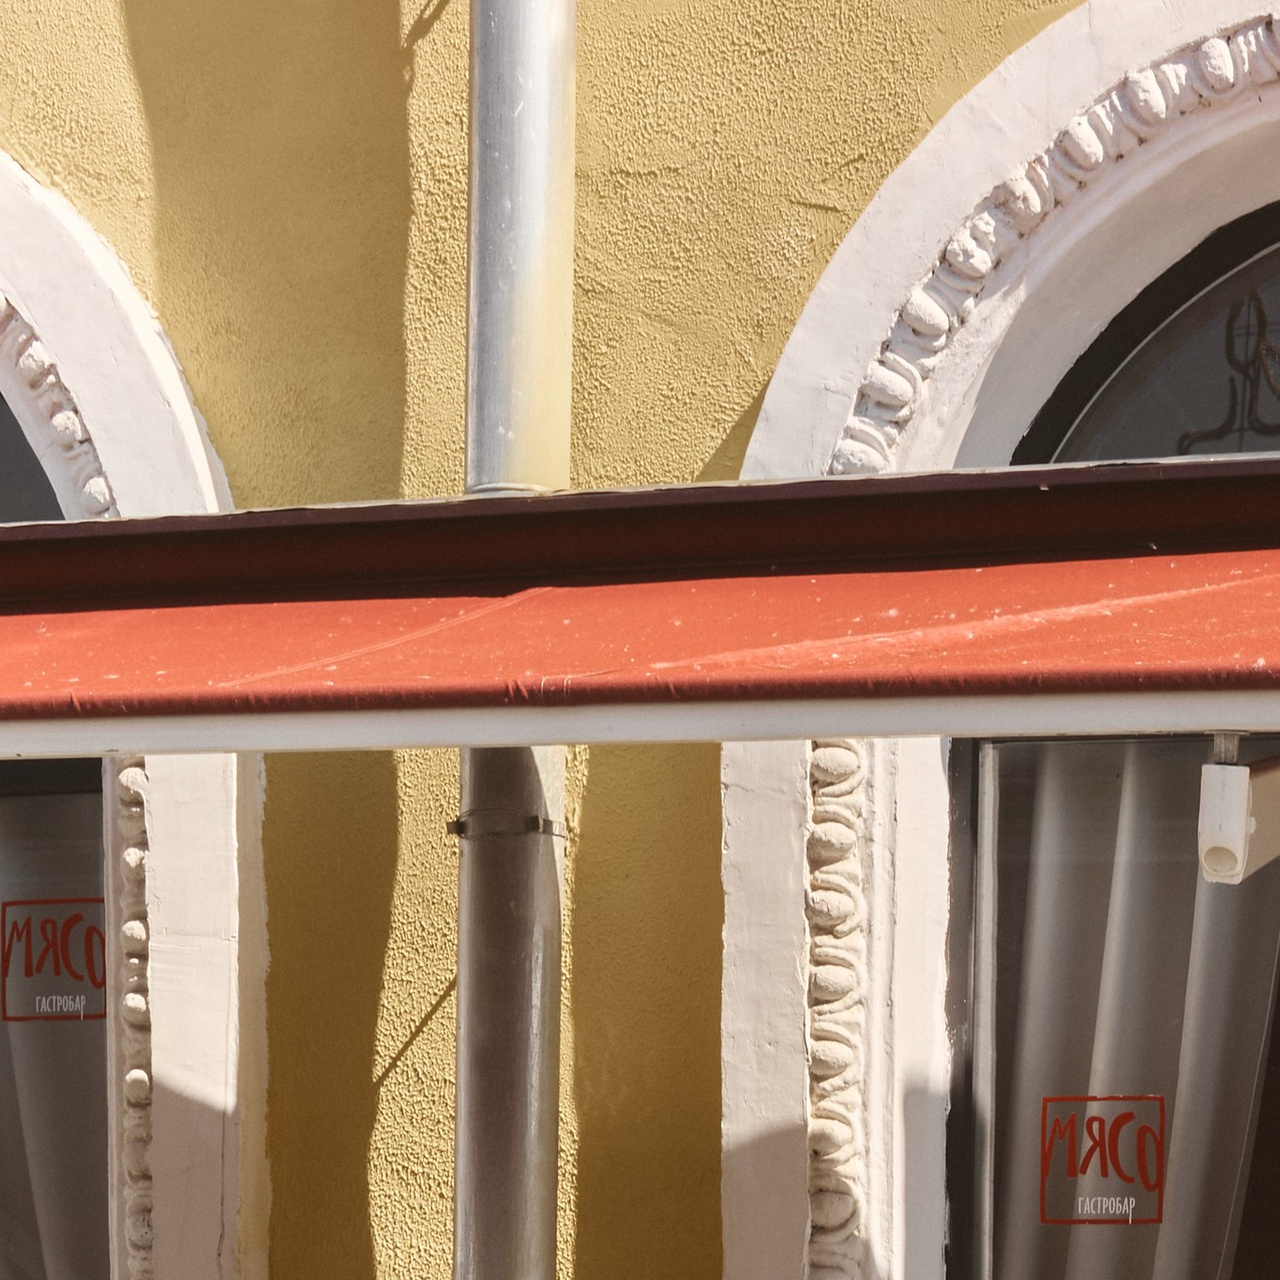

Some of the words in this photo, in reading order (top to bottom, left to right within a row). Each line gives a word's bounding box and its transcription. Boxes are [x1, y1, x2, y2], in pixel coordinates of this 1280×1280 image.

[5, 913, 105, 989] МЯСО
[35, 995, 86, 1020] ГАСТРОБАР
[1042, 1111, 1164, 1192] МЯСО
[1078, 1197, 1136, 1225] ГАСТРОБАР
